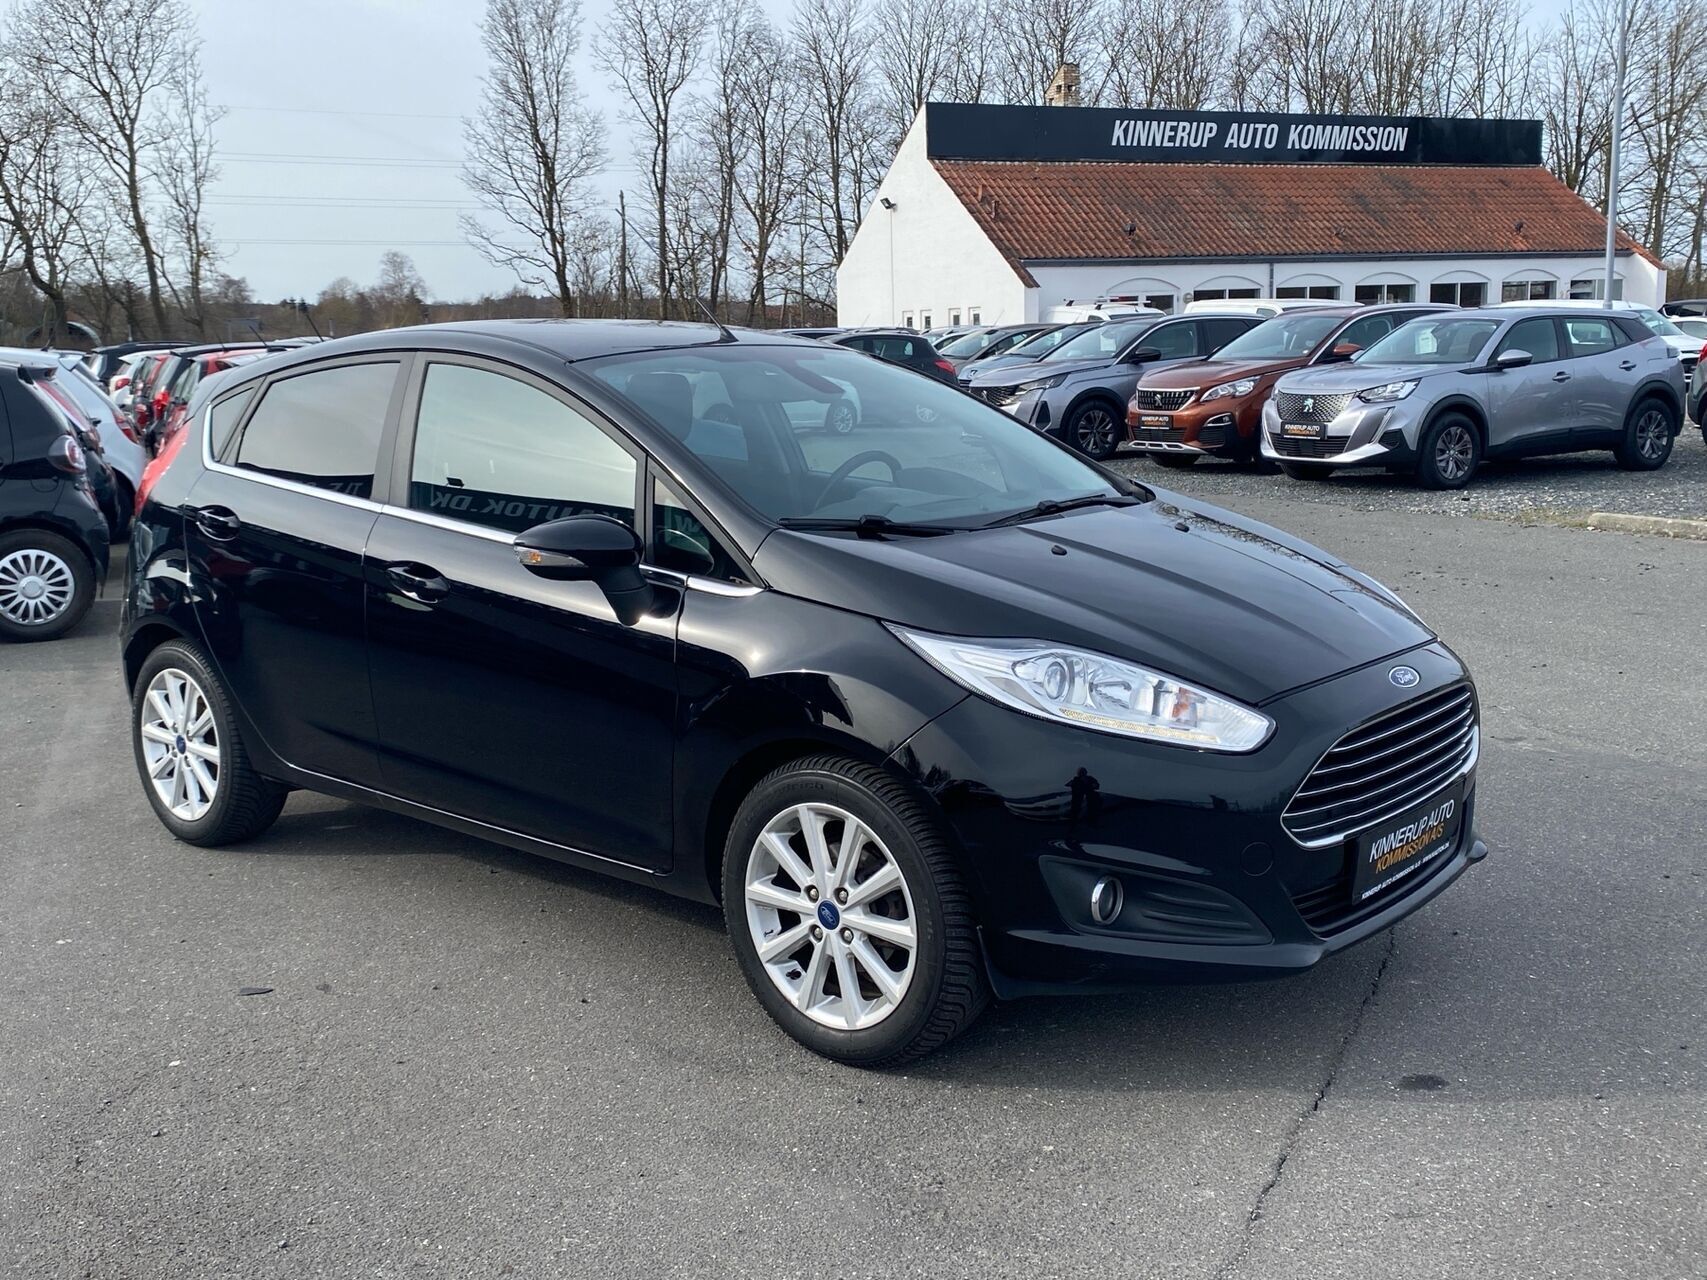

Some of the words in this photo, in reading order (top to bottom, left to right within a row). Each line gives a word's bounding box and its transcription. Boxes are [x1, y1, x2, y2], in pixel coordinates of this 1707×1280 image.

[1111, 119, 1218, 148] KINNERUP
[1224, 122, 1279, 149] AUTO
[1287, 124, 1409, 152] KOMMISSION
[1369, 815, 1428, 863] KINNERUP
[1426, 799, 1455, 828] AUTO
[1375, 831, 1430, 874] KOMMISSION
